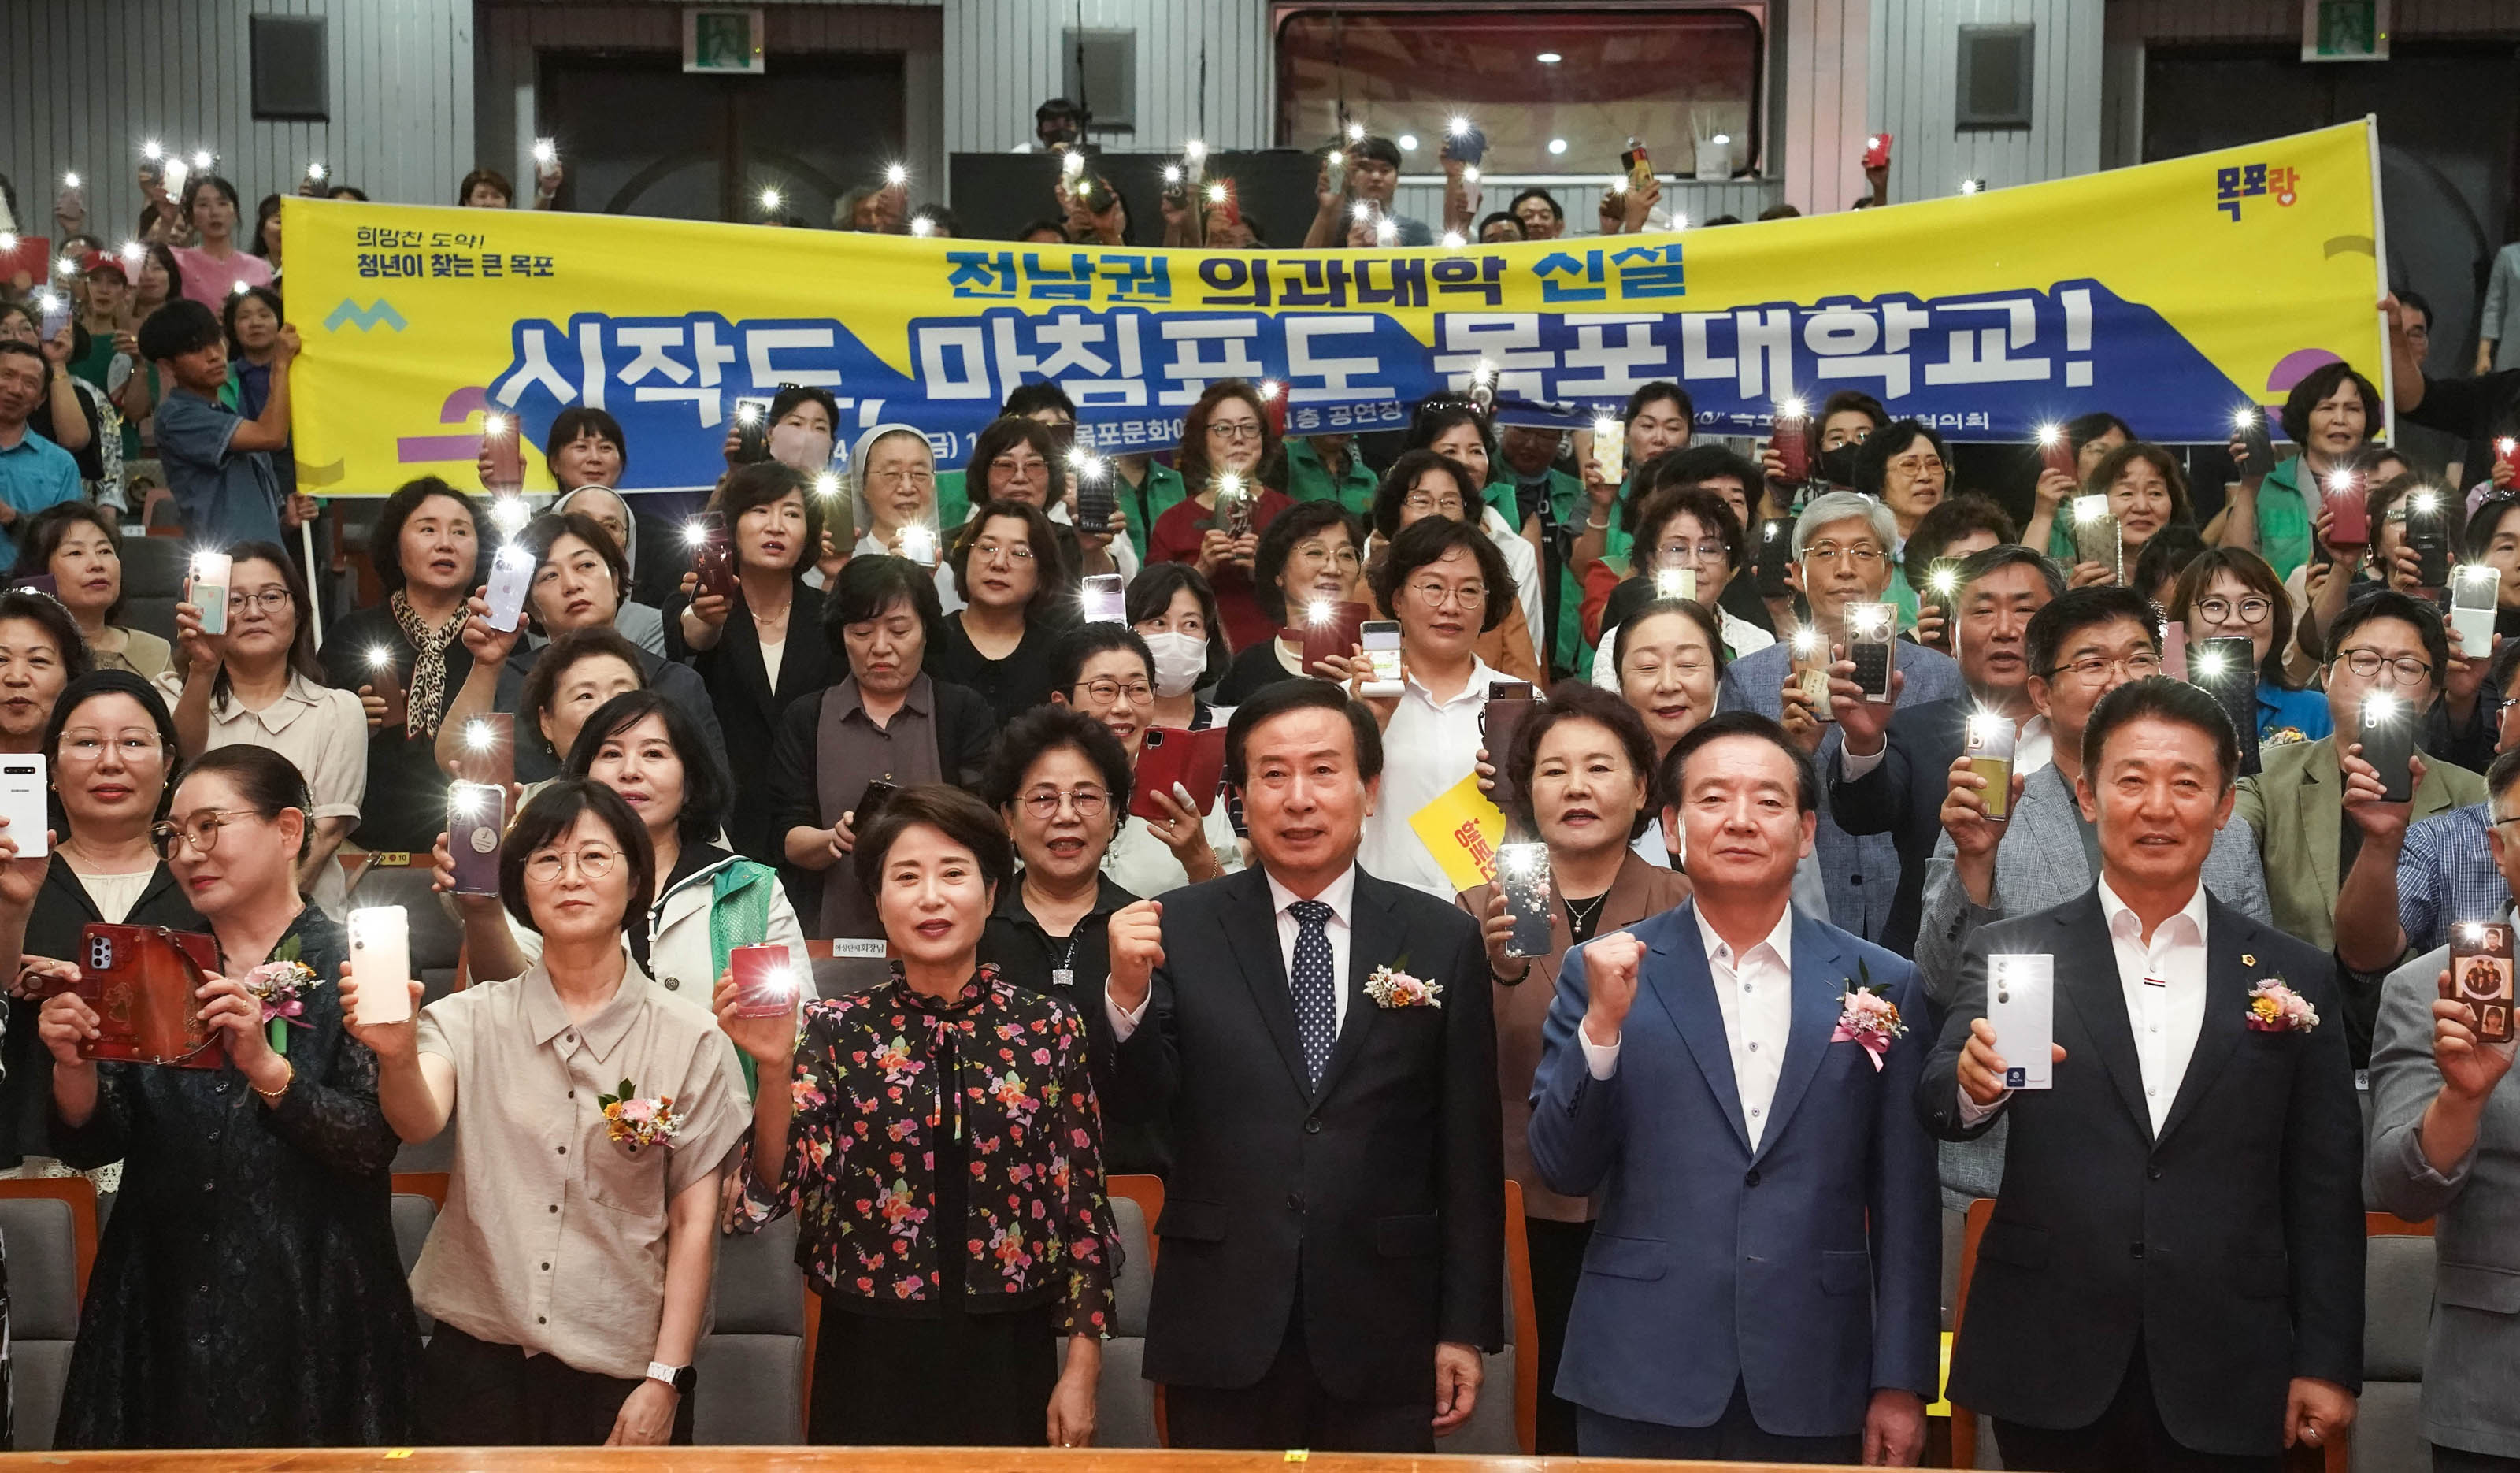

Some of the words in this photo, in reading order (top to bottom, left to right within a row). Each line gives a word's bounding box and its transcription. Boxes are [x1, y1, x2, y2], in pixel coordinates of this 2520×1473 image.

[2218, 164, 2300, 222] 목포랑
[357, 226, 423, 248] 희망찬
[430, 233, 485, 249] 도약!
[358, 254, 424, 277] 청년이
[431, 254, 474, 277] 찾는
[481, 254, 502, 277] 큰
[510, 254, 554, 278] 목포
[947, 251, 1172, 304] 전남권
[1199, 255, 1506, 308] 의과대학
[1532, 243, 1686, 304] 신설
[918, 314, 1396, 408] 마침표도
[1434, 288, 2094, 405] 목포대학교!
[1329, 400, 1404, 426] 공연장
